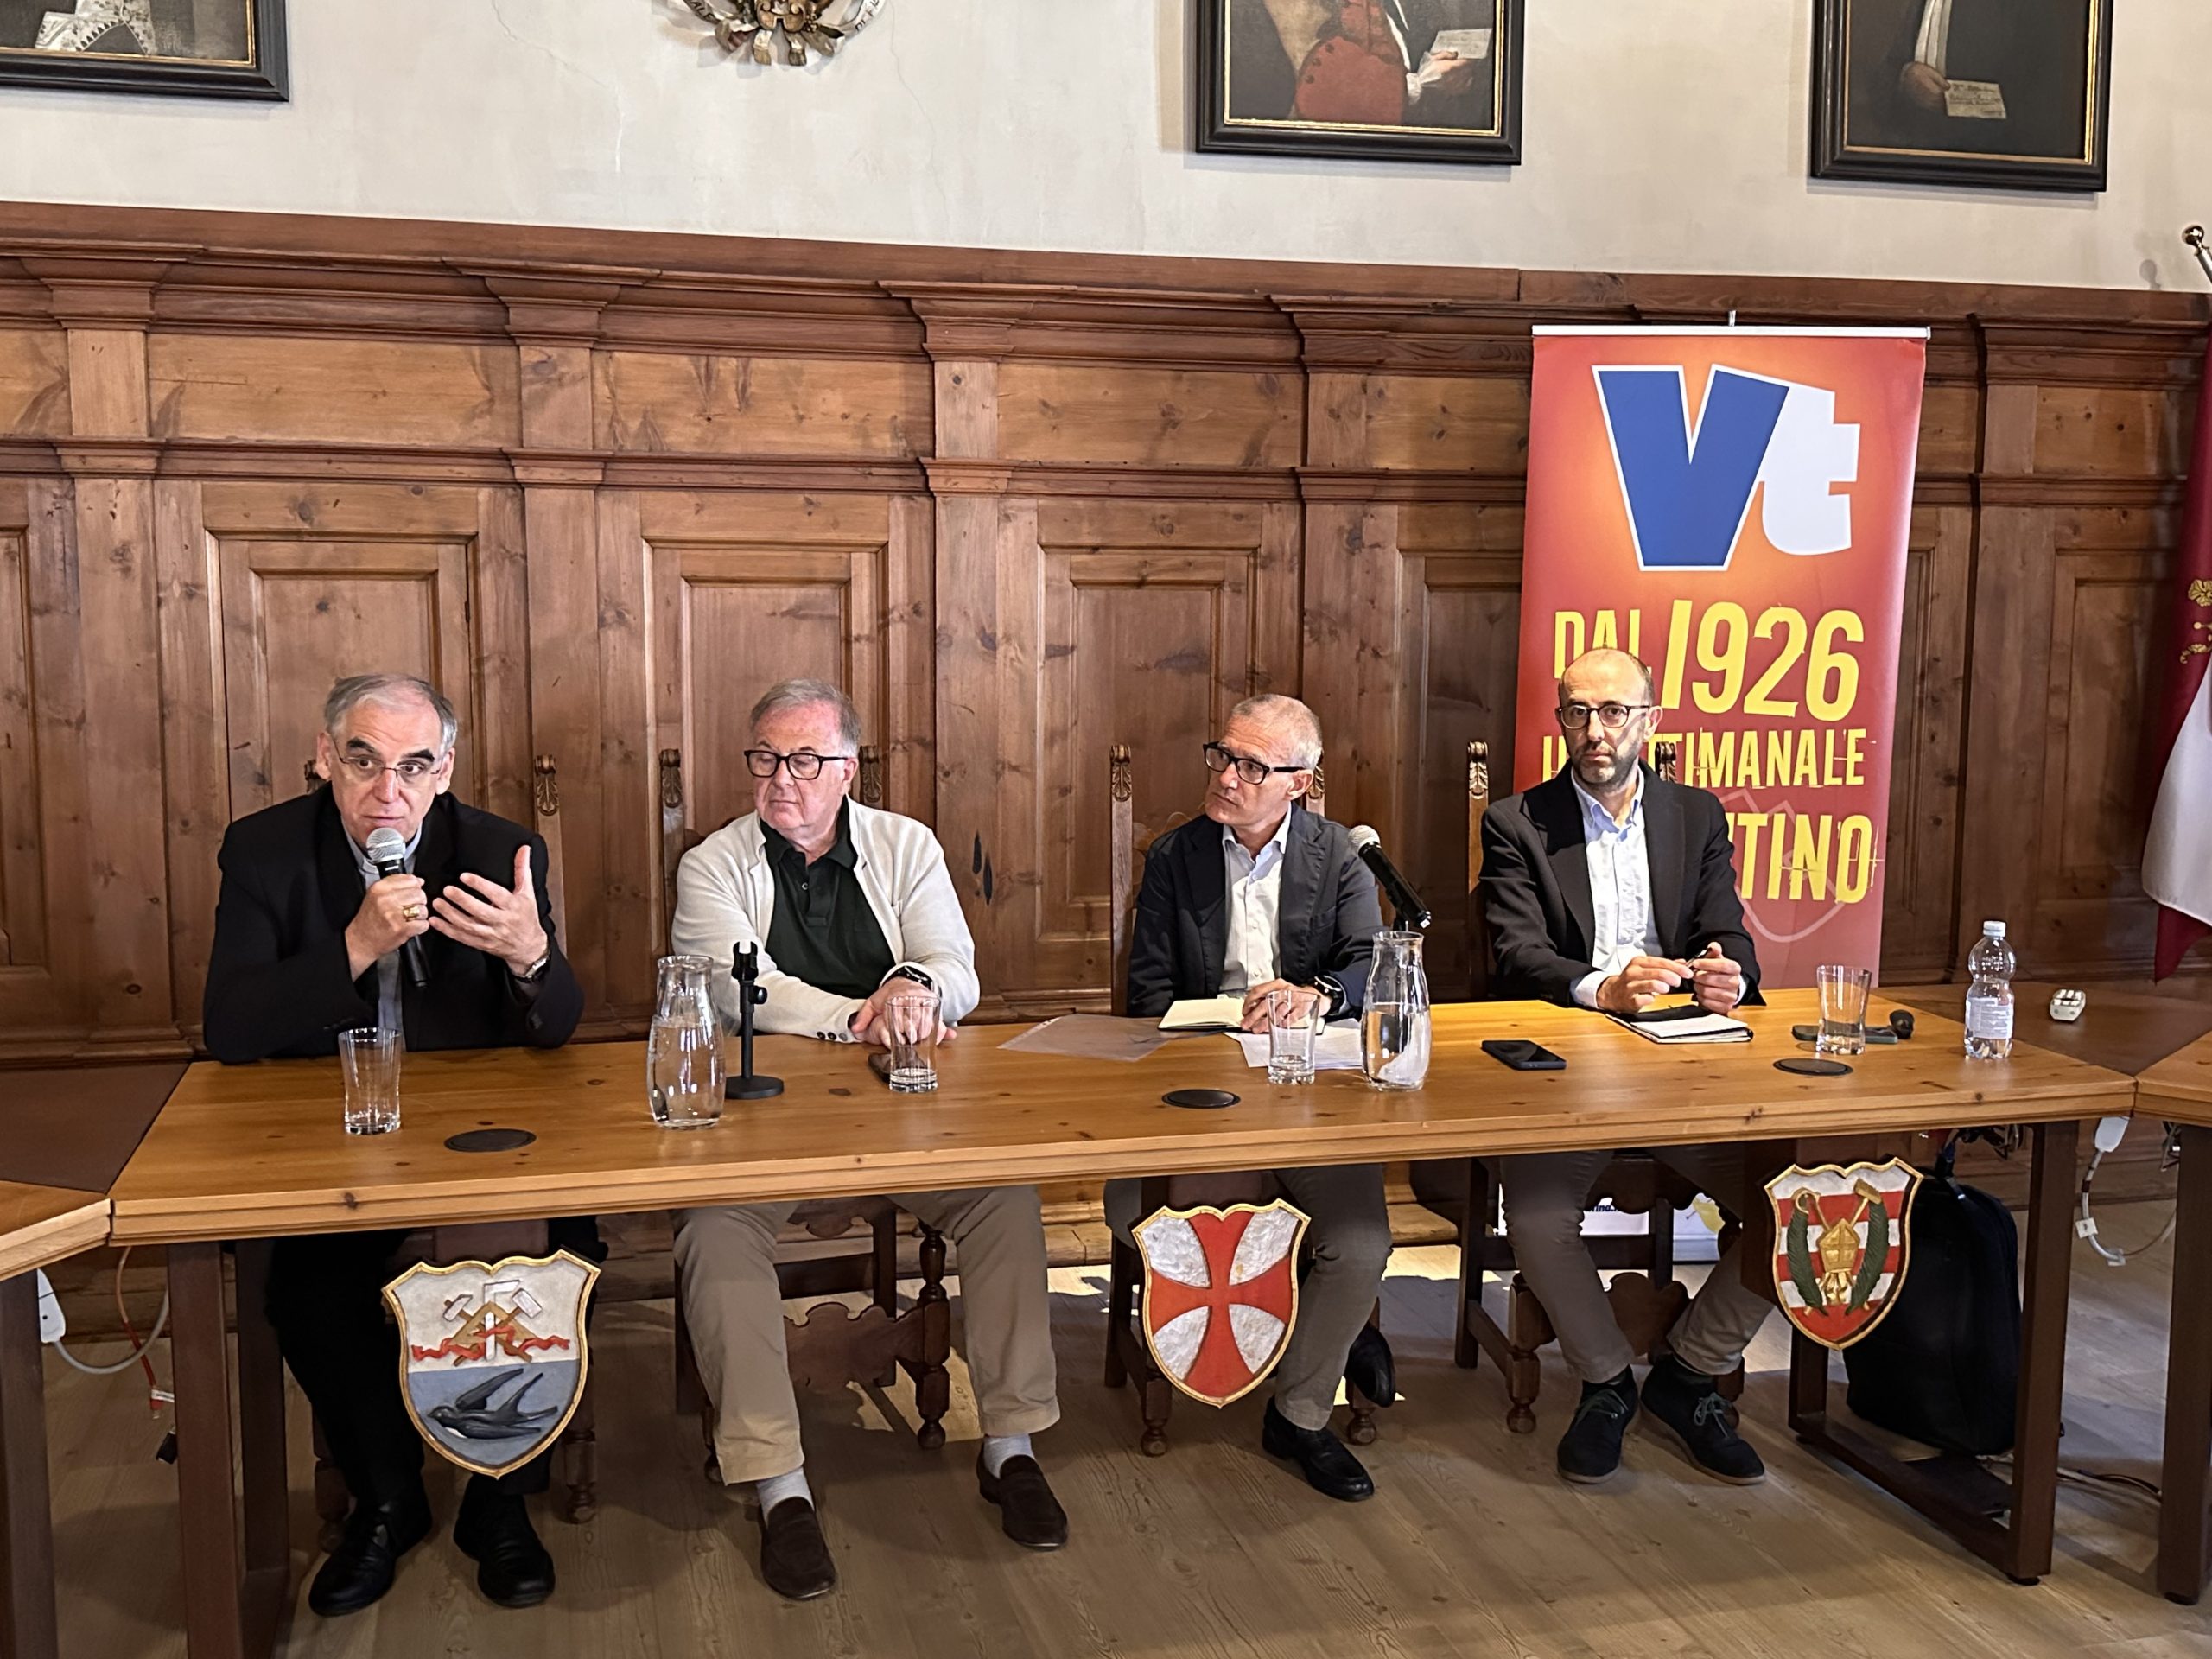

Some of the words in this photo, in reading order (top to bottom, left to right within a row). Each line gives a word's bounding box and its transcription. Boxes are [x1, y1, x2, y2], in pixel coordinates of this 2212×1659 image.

[1661, 600, 1865, 721] 1926
[1643, 728, 1866, 788] TTIMANALE
[1727, 813, 1872, 904] TINO
